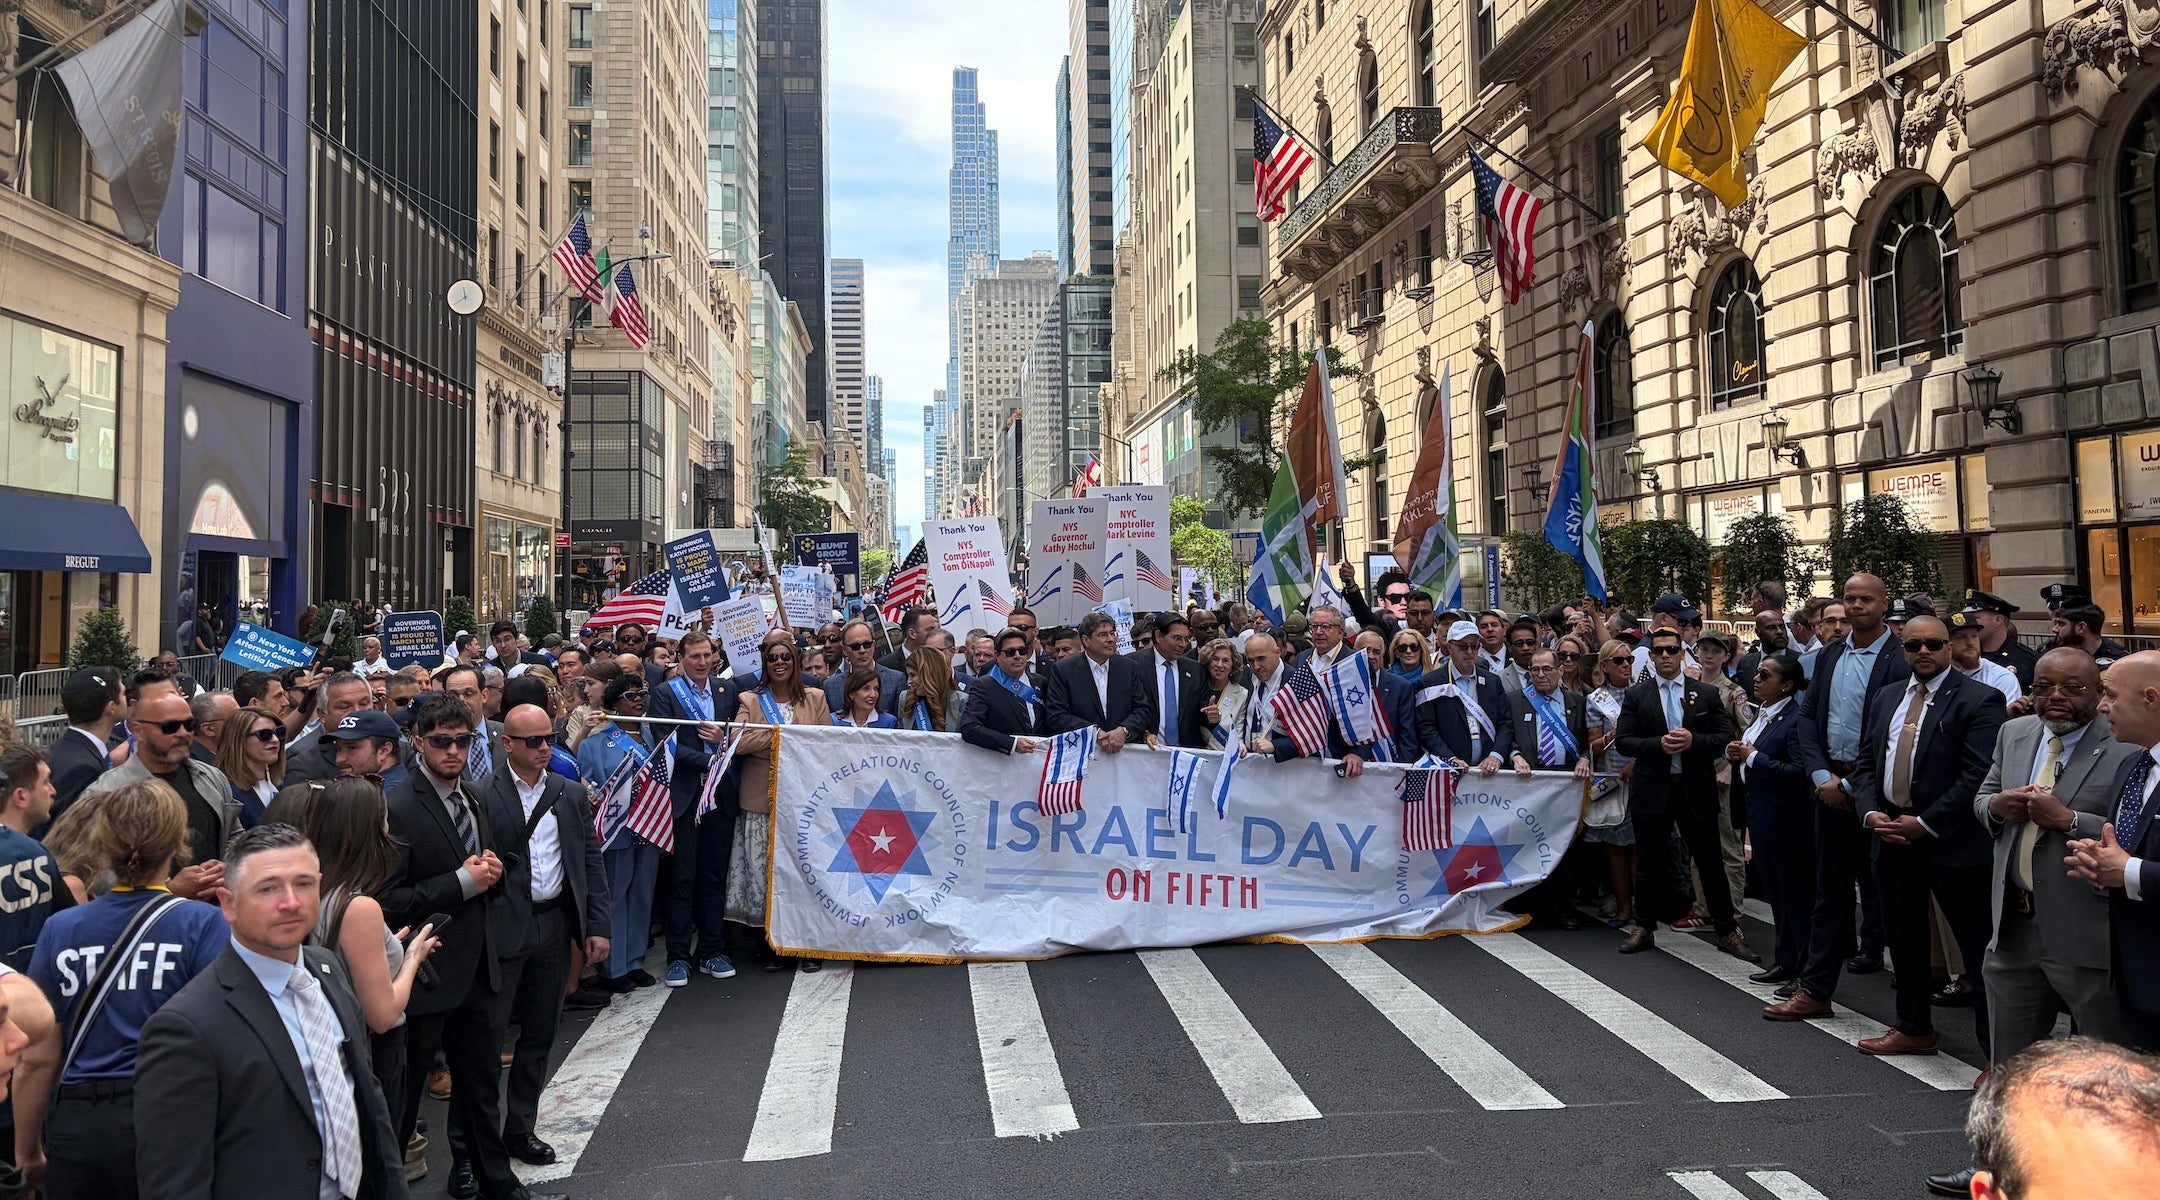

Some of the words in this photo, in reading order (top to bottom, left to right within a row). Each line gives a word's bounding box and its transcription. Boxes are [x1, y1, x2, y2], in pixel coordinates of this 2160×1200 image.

[1882, 472, 1942, 492] WEMPE
[1135, 492, 1153, 501] You
[1713, 495, 1754, 511] WEMPE
[1047, 505, 1075, 516] Thank
[1078, 505, 1094, 514] You
[1120, 509, 1137, 519] NYC
[938, 524, 966, 535] Thank
[968, 523, 985, 533] You
[1062, 522, 1078, 532] NYS
[1108, 519, 1155, 531] omptroller
[1051, 533, 1088, 543] Governor
[1127, 530, 1155, 539] Levine
[669, 549, 688, 559] KATHY
[687, 542, 711, 554] HOCHUL
[673, 537, 704, 551] GOVERNOR
[816, 541, 849, 550] LEUMIT
[957, 540, 974, 550] NYS
[1042, 543, 1066, 554] Kathy
[1068, 541, 1095, 551] Hochul
[684, 550, 709, 562] PROUD
[687, 555, 713, 567] MARCH
[816, 550, 848, 558] GROUP
[943, 549, 991, 563] Comptroller
[65, 555, 100, 569] BREGUET
[685, 567, 693, 575] IN
[694, 563, 708, 572] THE
[942, 563, 960, 572] Tom
[961, 557, 995, 570] DiNapoli
[680, 572, 704, 584] ISRAEL
[704, 566, 718, 576] DAY
[688, 580, 716, 594] PARADE
[689, 579, 700, 587] ON
[719, 613, 736, 622] KATHY
[736, 607, 759, 618] HOCHUL
[722, 602, 752, 615] GOVERNOR
[395, 619, 430, 627] GOVERNOR
[733, 614, 757, 625] PROUD
[736, 620, 761, 632] MARCH
[390, 638, 415, 646] MARCH
[728, 636, 752, 647] ISRAEL
[753, 630, 766, 639] DAY
[234, 638, 270, 657] Attorney
[271, 651, 305, 668] General
[258, 637, 277, 649] New
[278, 643, 297, 657] York
[396, 644, 420, 652] ISRAEL
[737, 645, 761, 657] PARAD
[738, 643, 749, 651] ON
[238, 649, 265, 665] Letitia
[264, 659, 283, 670] Jam
[831, 755, 921, 784] RELATIONS
[924, 770, 967, 838] COUNCIL
[797, 781, 830, 886] COMMUNITY
[987, 800, 1217, 863] ISRAEL
[1241, 816, 1378, 873] DAY
[1451, 793, 1512, 811] ATIONS
[1516, 807, 1552, 867] COUNCIL
[954, 843, 967, 868] OF
[0, 855, 53, 913] CSS
[930, 871, 959, 908] NEW
[1106, 868, 1152, 903] ON
[1167, 872, 1258, 910] FIFTH
[815, 889, 871, 928] JEWISH
[884, 904, 930, 929] YORK
[56, 942, 183, 997] STFF
